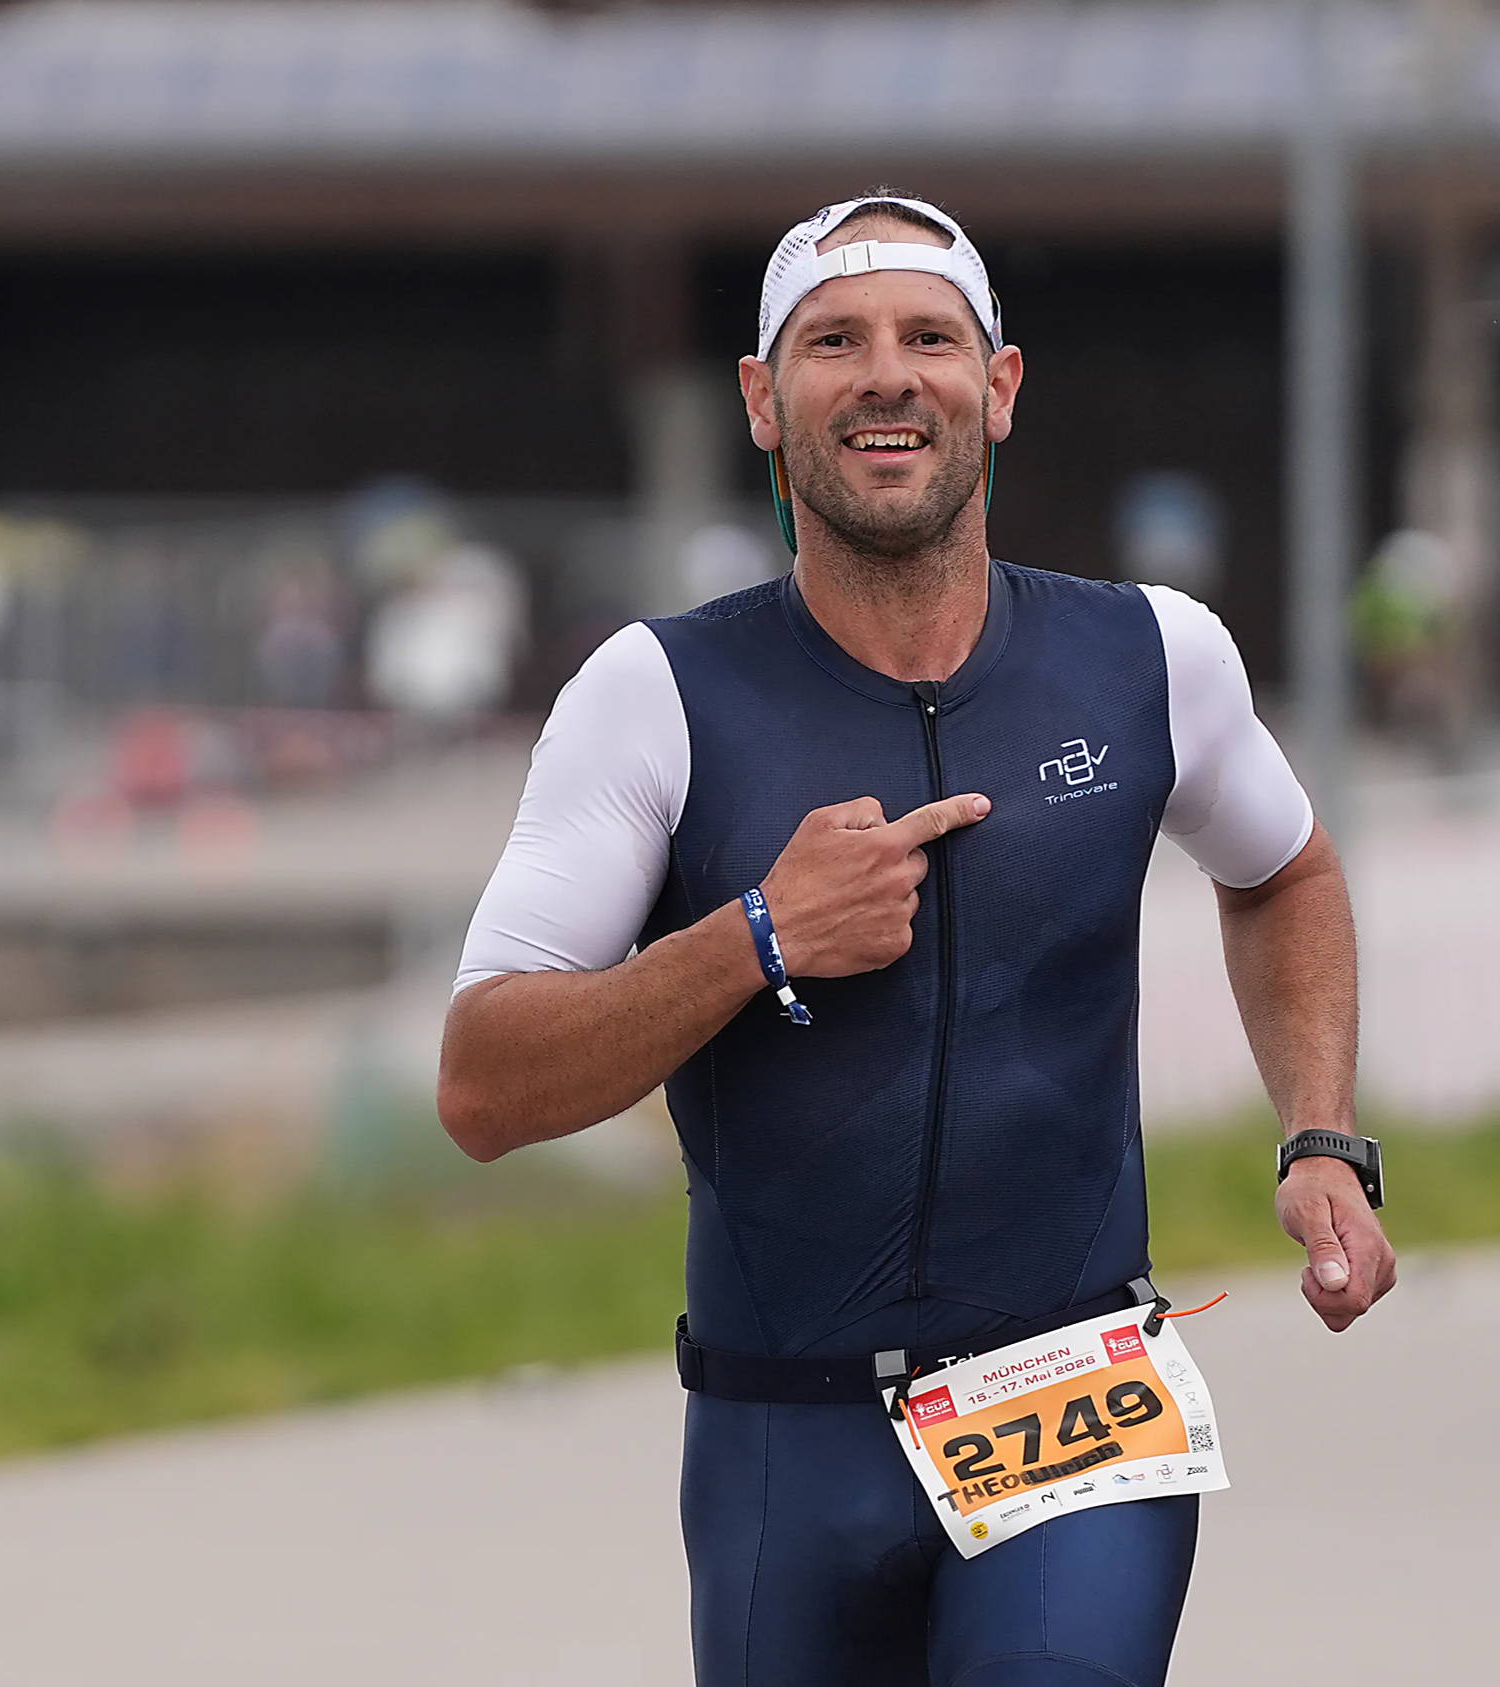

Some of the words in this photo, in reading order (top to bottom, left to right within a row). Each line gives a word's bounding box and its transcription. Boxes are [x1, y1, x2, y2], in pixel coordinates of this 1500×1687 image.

[1044, 781, 1118, 805] Trinovate
[1118, 1339, 1140, 1350] CUP
[967, 1381, 1023, 1405] 15.-17.
[1025, 1369, 1052, 1386] Mai
[1055, 1355, 1096, 1376] 2026
[982, 1347, 1071, 1384] MÜNCHEN
[926, 1400, 951, 1413] CUP
[943, 1380, 1164, 1481] 2749
[937, 1473, 1021, 1512] THEO
